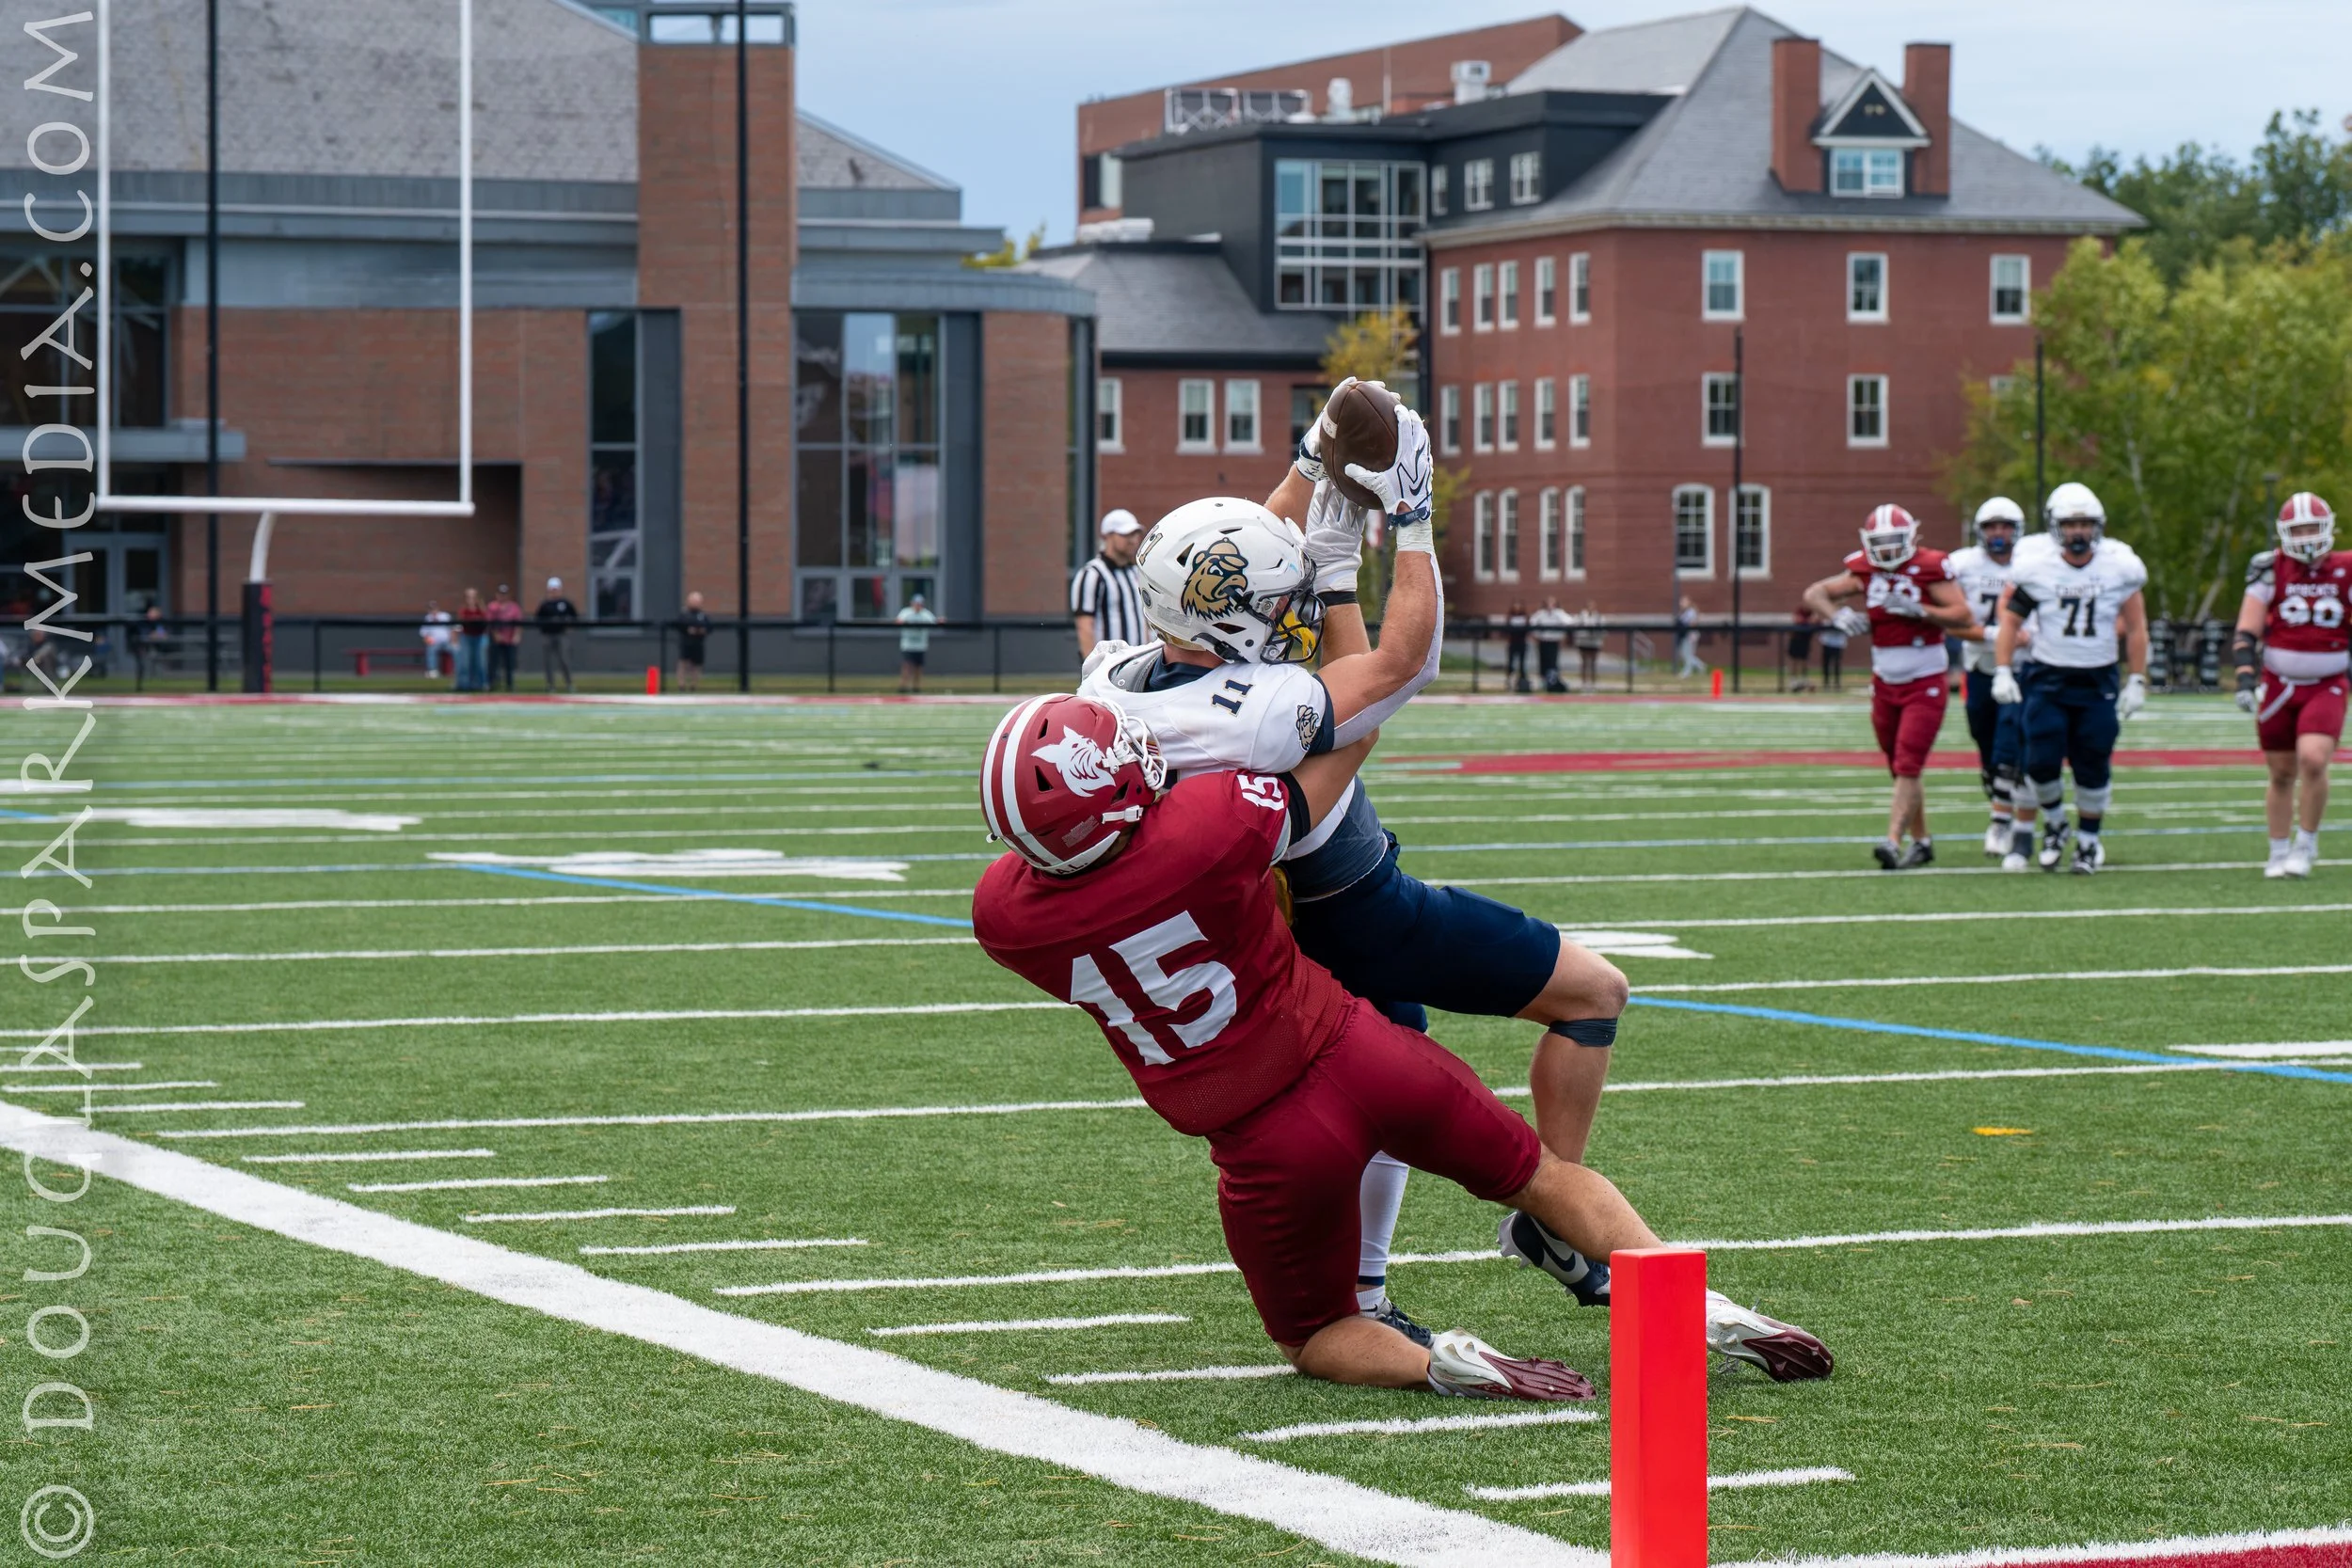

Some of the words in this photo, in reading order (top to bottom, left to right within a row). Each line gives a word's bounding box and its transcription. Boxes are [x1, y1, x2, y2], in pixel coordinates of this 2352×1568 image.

[2060, 596, 2096, 637] 71
[1211, 679, 1254, 717] 11
[1236, 774, 1285, 811] 15
[1070, 910, 1238, 1067] 15
